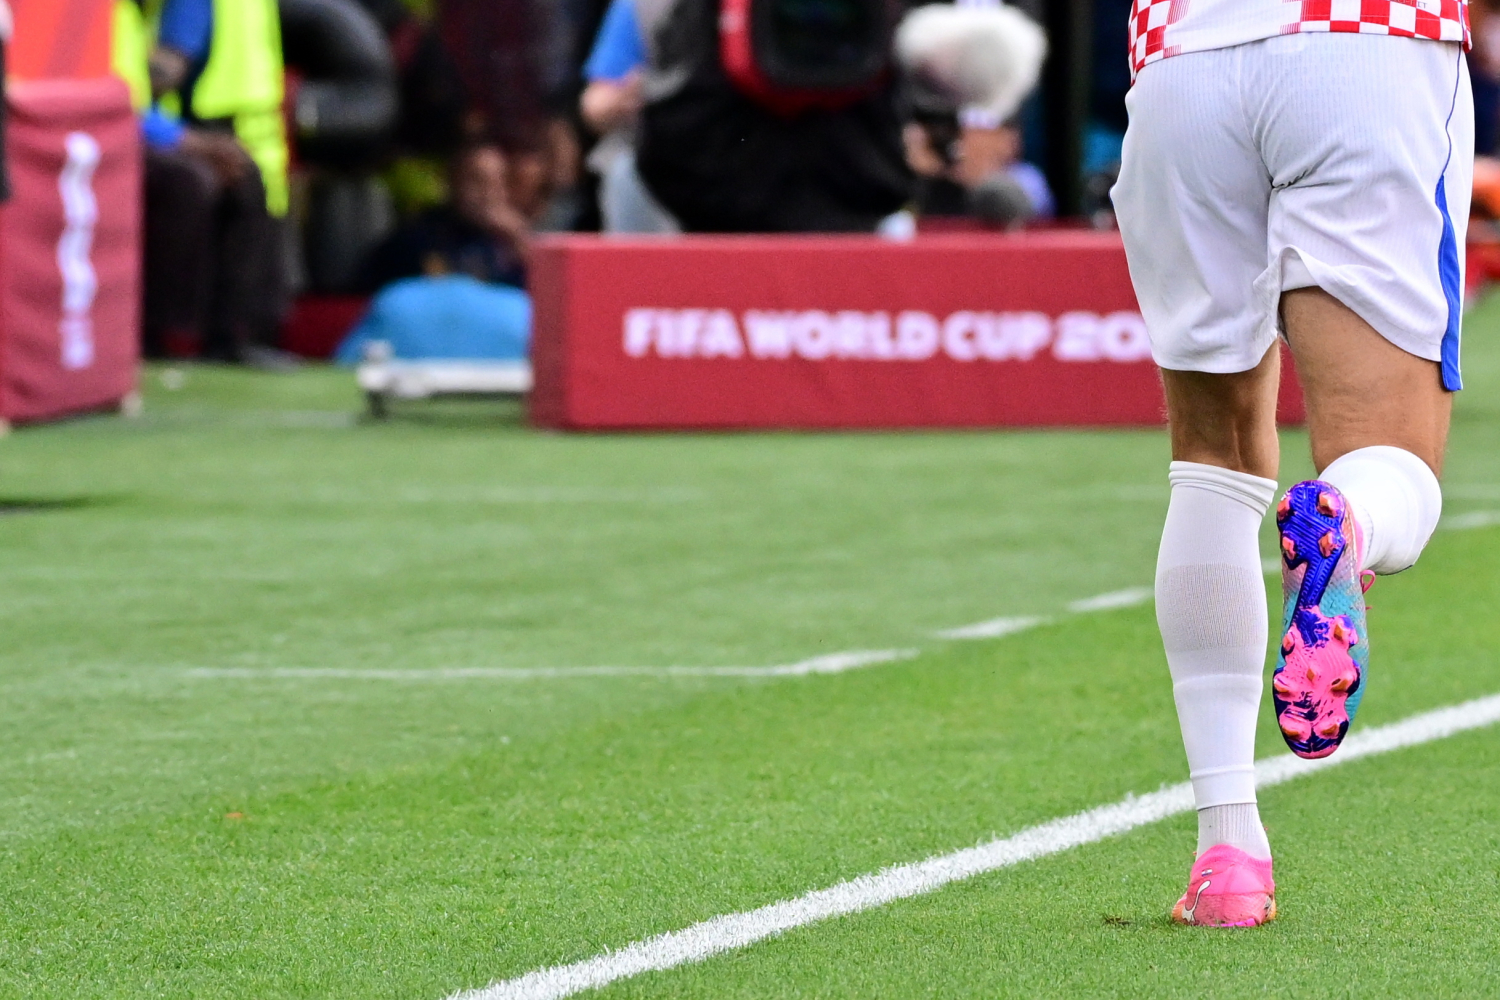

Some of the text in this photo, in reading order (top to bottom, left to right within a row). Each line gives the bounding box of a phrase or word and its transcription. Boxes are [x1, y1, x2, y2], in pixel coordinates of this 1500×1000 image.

[623, 308, 1151, 362] FIFA WORLD CUP 20
